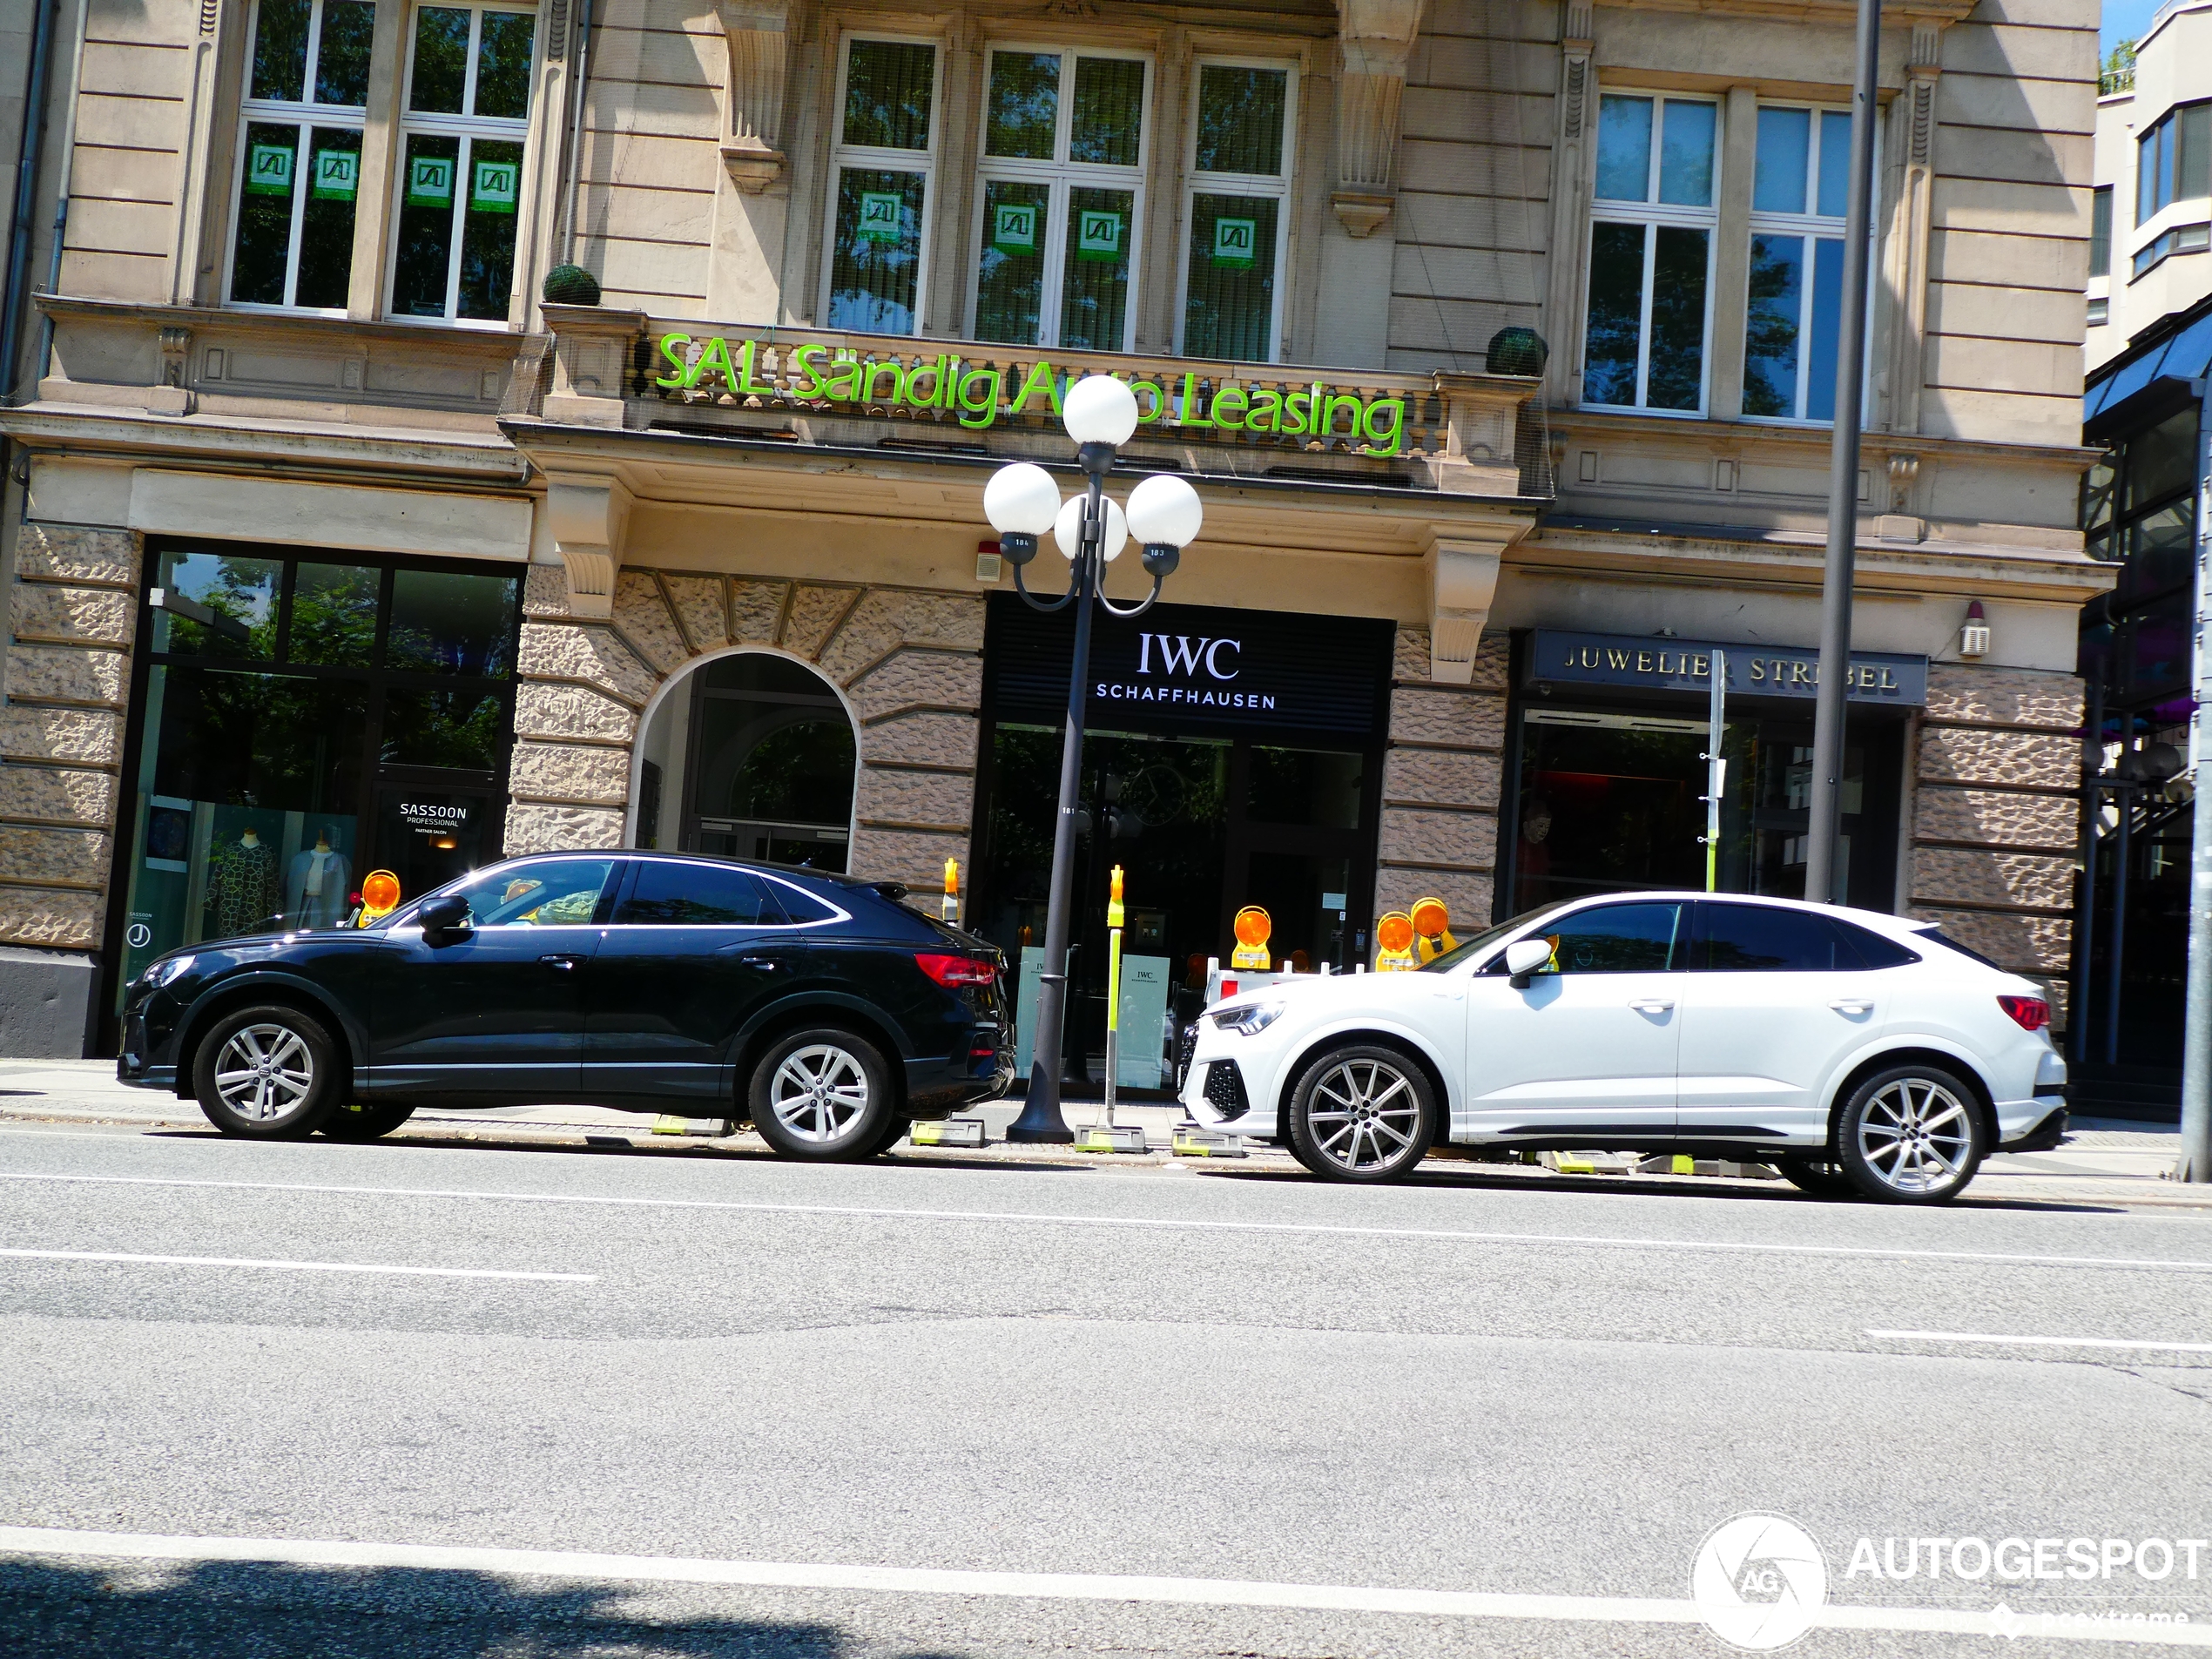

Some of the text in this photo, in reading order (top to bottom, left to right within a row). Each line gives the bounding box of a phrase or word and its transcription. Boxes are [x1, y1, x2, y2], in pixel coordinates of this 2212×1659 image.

[656, 333, 1405, 458] SAL Sändig Ao Leasing
[1136, 633, 1241, 680] IWC
[1096, 683, 1275, 709] SCHAFFHAUSEN
[400, 803, 467, 819] SASSOON
[407, 816, 459, 827] PROFESSIONAL
